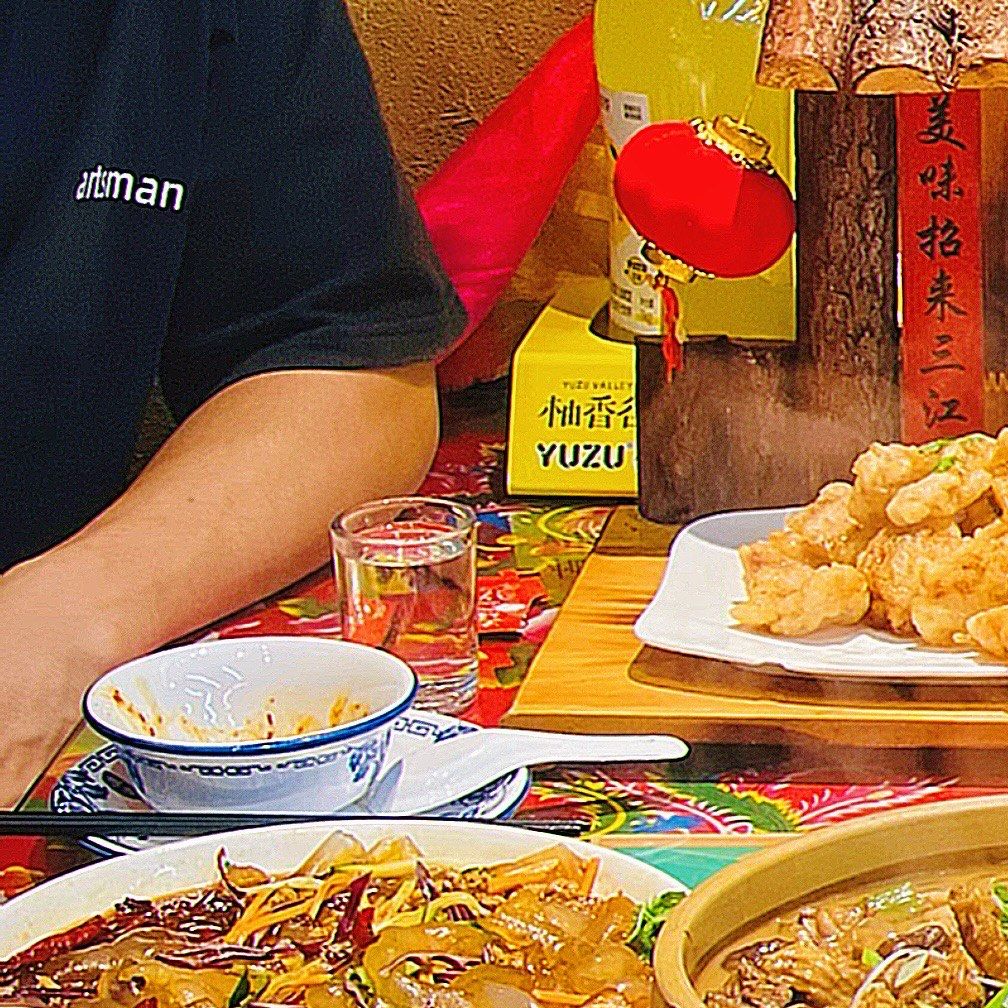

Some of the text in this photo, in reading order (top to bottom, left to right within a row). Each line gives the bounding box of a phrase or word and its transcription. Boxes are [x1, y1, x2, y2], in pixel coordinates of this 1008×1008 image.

[914, 94, 967, 429] 美味招来三江
[536, 442, 626, 470] YUZU
